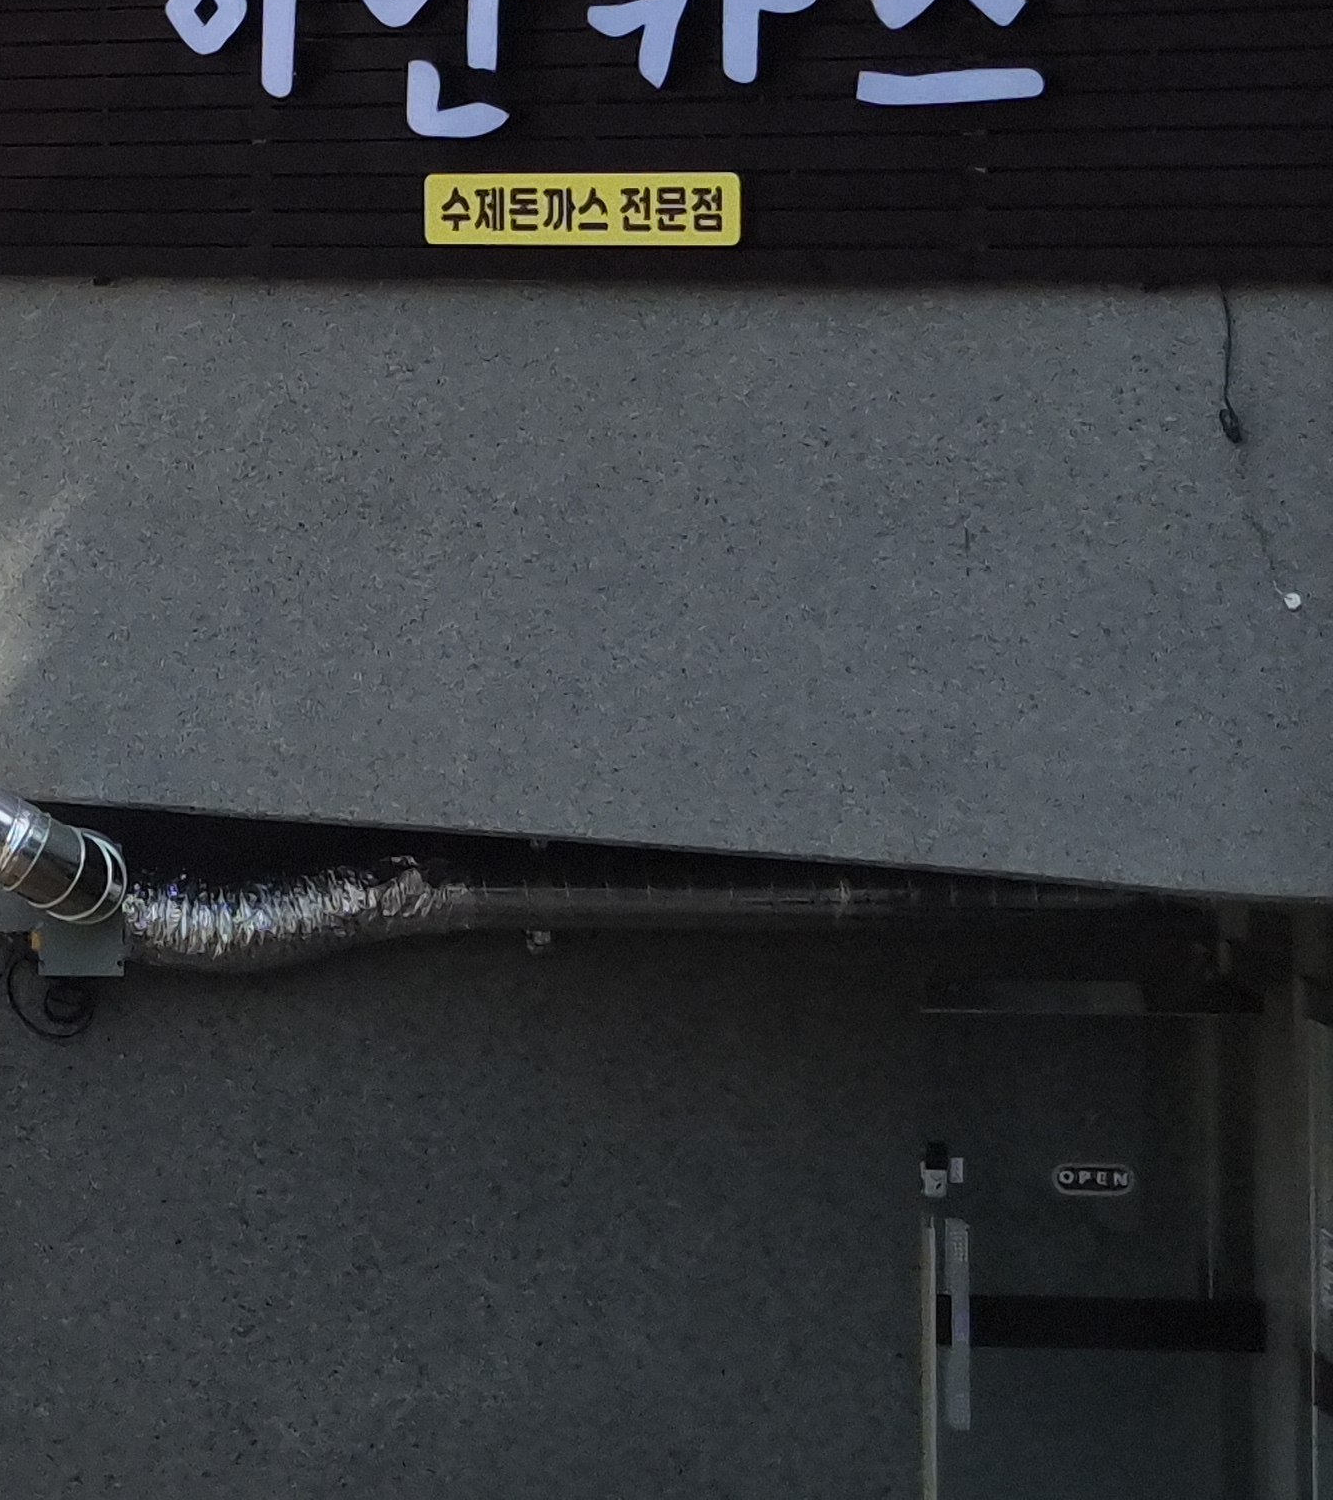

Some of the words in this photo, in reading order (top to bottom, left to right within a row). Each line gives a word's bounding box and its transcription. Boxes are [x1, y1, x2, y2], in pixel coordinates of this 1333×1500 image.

[440, 185, 609, 232] 수제돈까스
[619, 185, 724, 232] 전문점
[1058, 1169, 1129, 1187] OPEN
